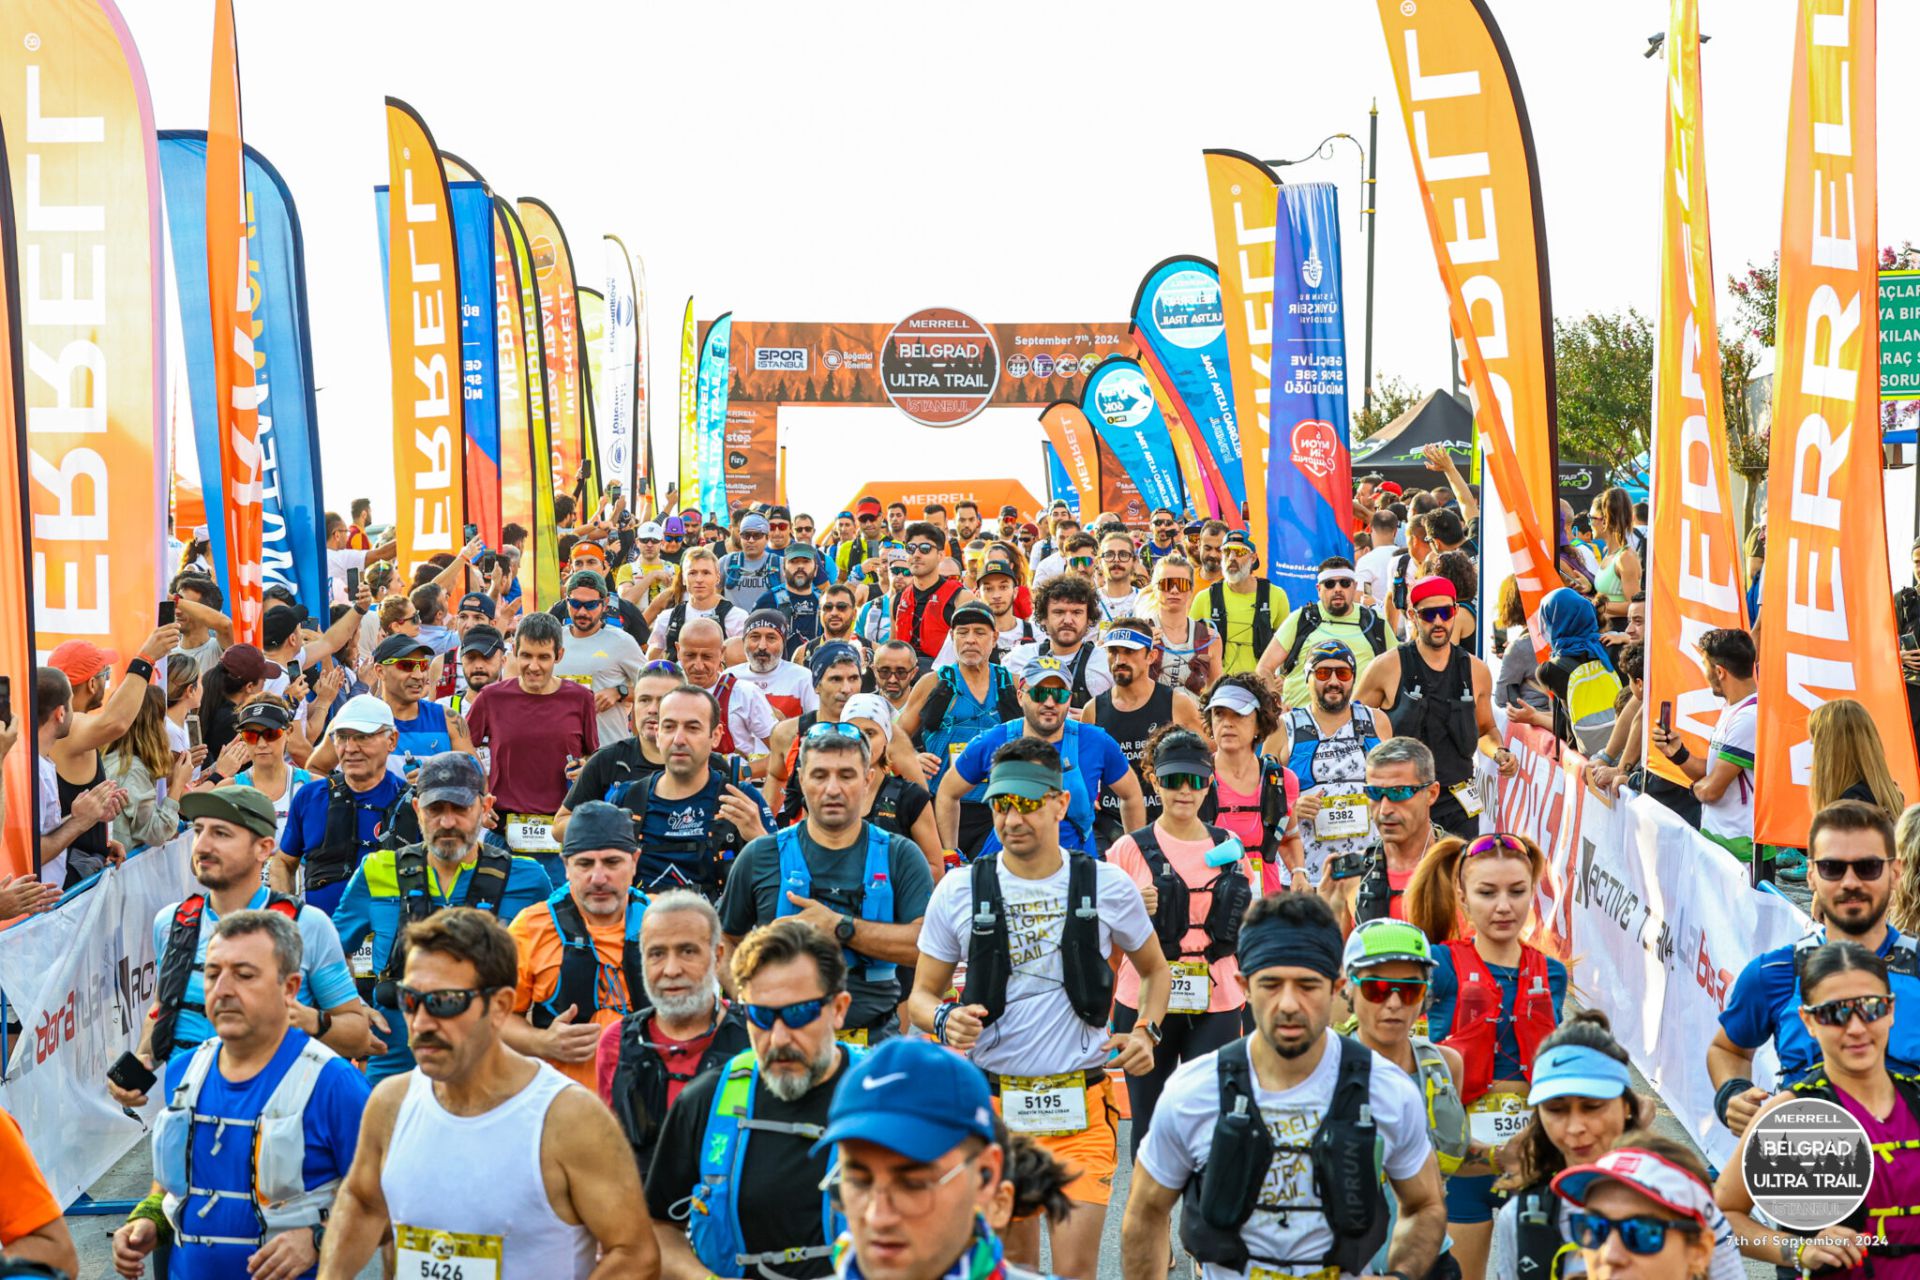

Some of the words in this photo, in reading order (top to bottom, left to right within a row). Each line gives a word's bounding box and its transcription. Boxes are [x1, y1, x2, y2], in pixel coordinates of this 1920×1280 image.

[909, 320, 971, 328] MERRELL
[1015, 335, 1072, 347] September
[1095, 335, 1119, 345] 2024
[758, 350, 803, 361] SPOR
[899, 343, 980, 358] BELGRAD
[844, 361, 873, 369] Yönetim
[890, 373, 940, 387] ULTRA
[944, 373, 989, 387] TRAIL
[906, 397, 972, 412] İSTANBUL
[726, 432, 752, 444] step
[730, 455, 745, 465] fizy
[902, 493, 977, 505] MERRELL
[1038, 656, 1061, 670] W
[1329, 810, 1354, 820] 5382
[522, 826, 546, 835] 5148
[1025, 1094, 1062, 1109] 5195
[1494, 1116, 1529, 1131] 5360
[1344, 1141, 1366, 1231] KIPRUN
[421, 1260, 463, 1280] 5426
